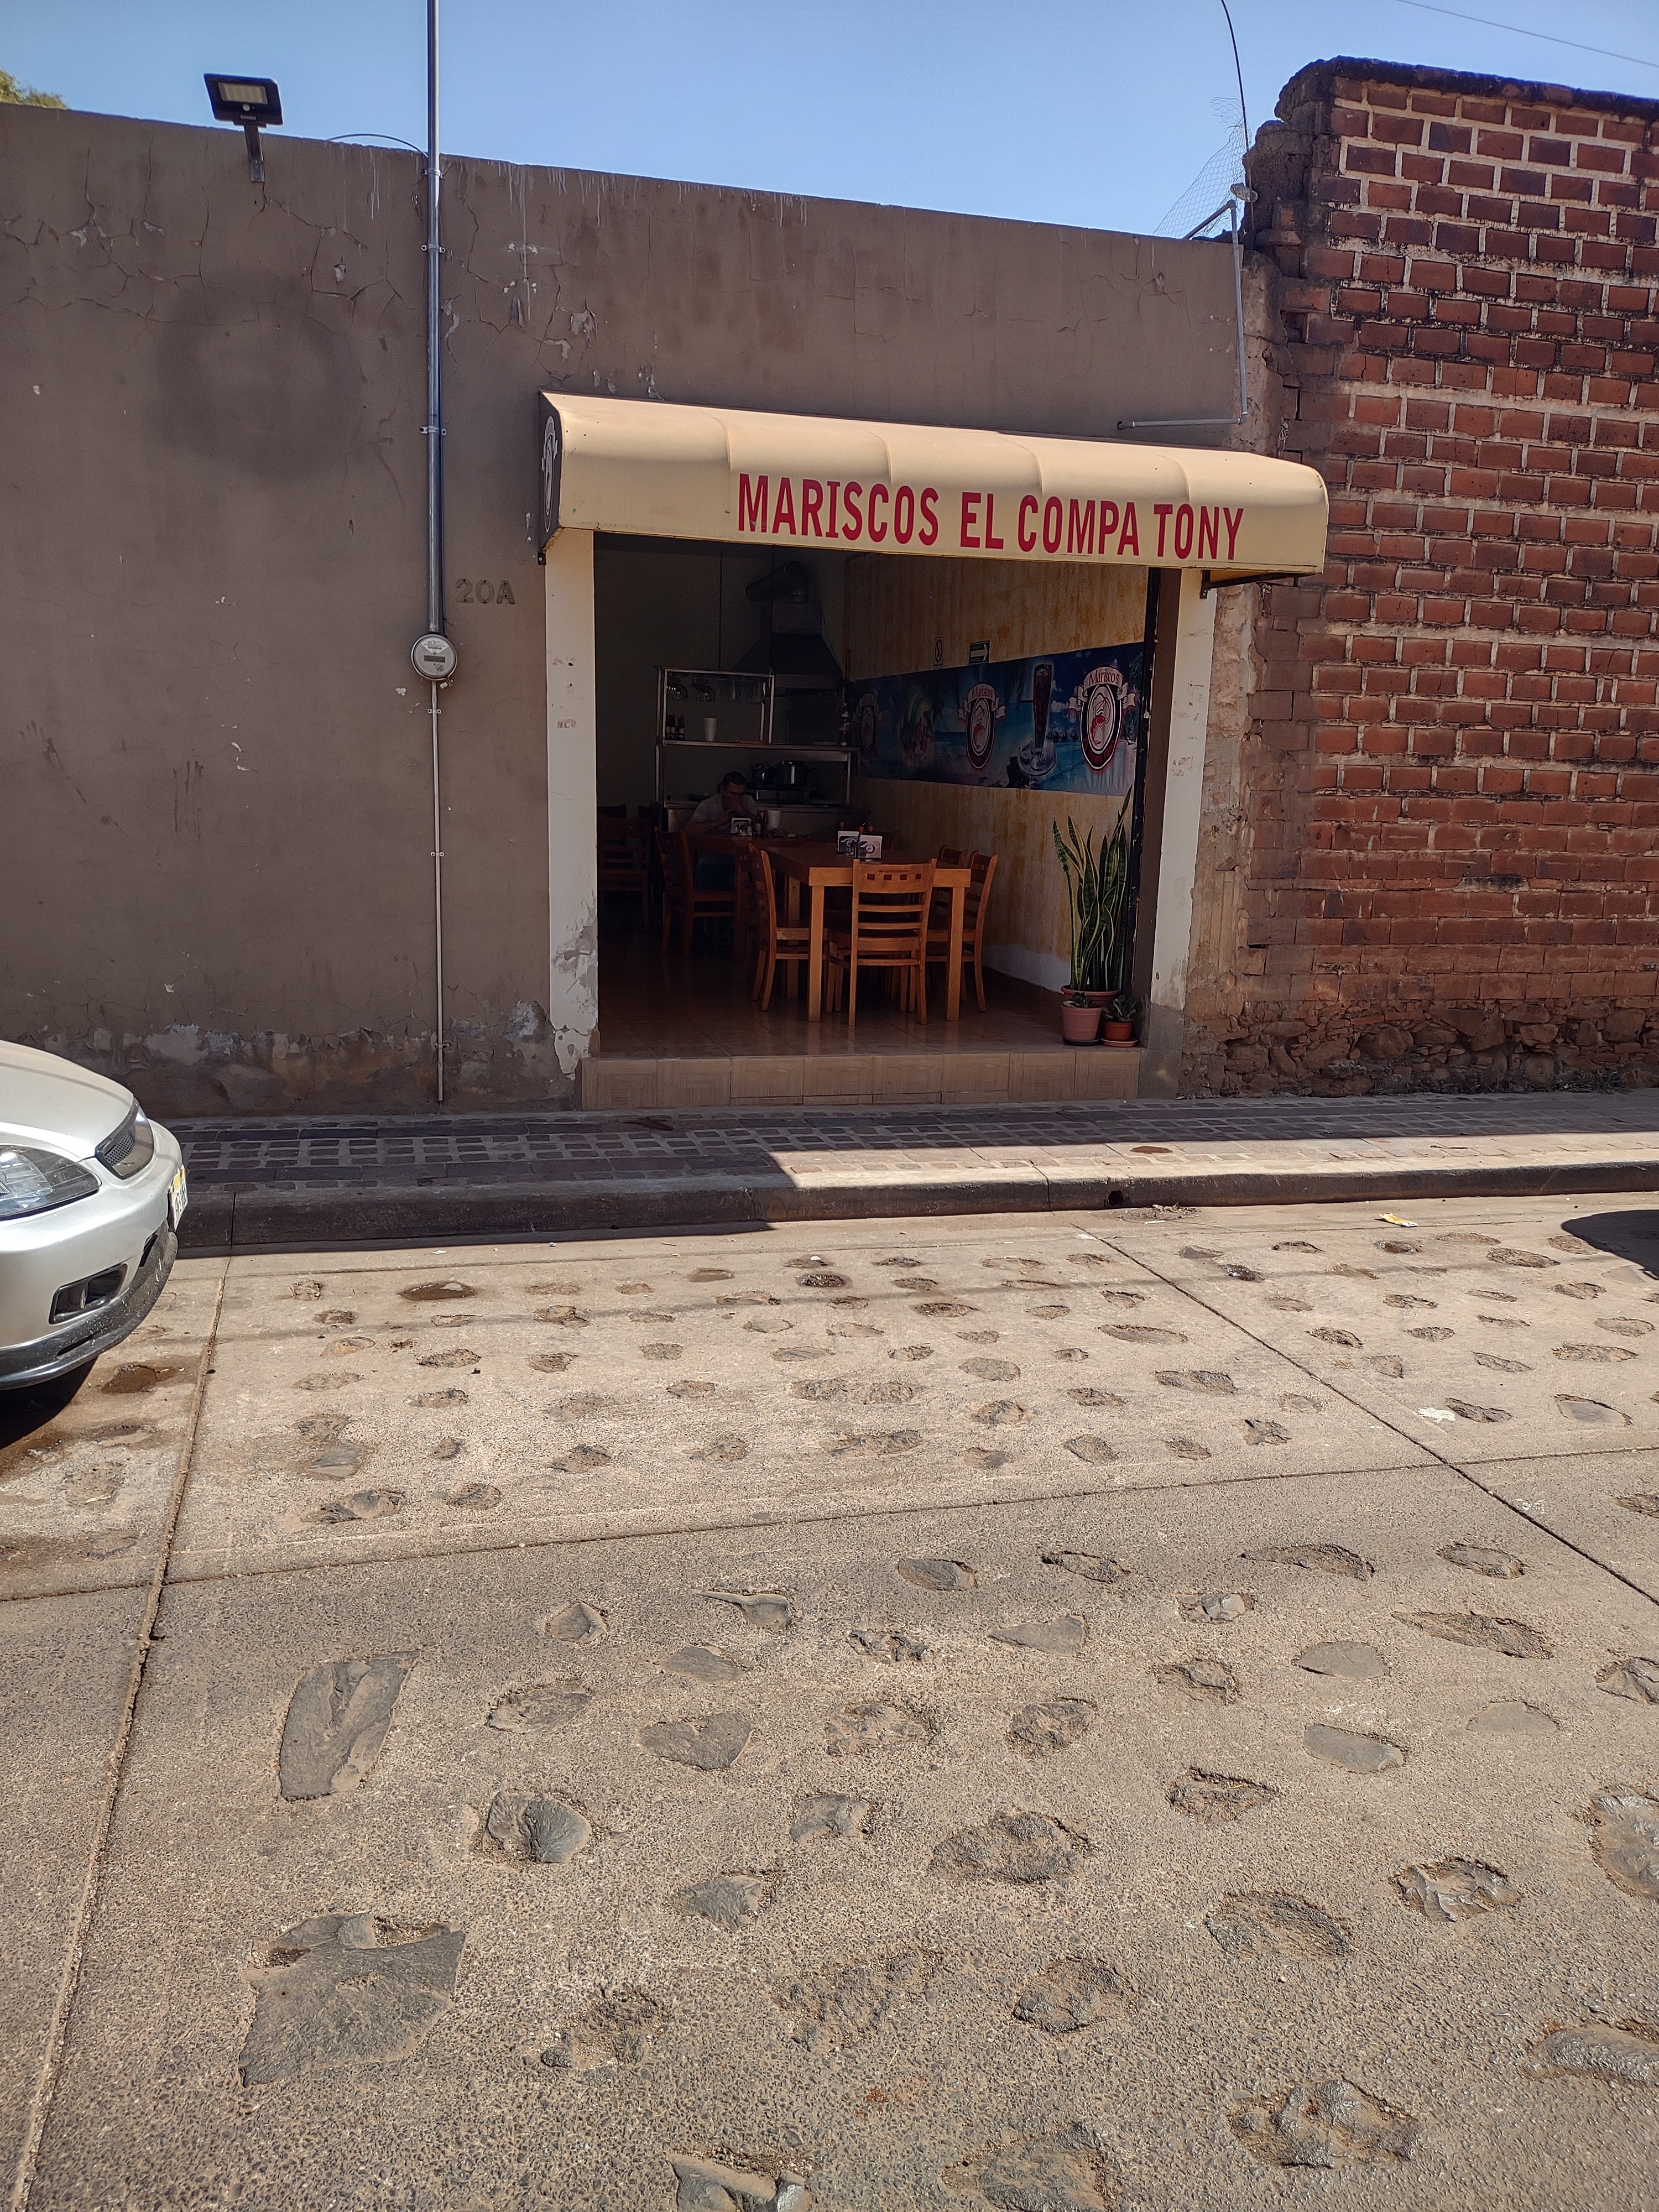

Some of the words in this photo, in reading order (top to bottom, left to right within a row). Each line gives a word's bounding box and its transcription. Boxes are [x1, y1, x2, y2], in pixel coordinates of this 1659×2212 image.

[738, 474, 938, 546] MARISCOS
[960, 492, 1004, 550] EL
[1018, 496, 1139, 555] COMPA
[1154, 503, 1244, 560] TONY
[455, 577, 515, 604] 20A
[1088, 669, 1119, 686] Mariscos
